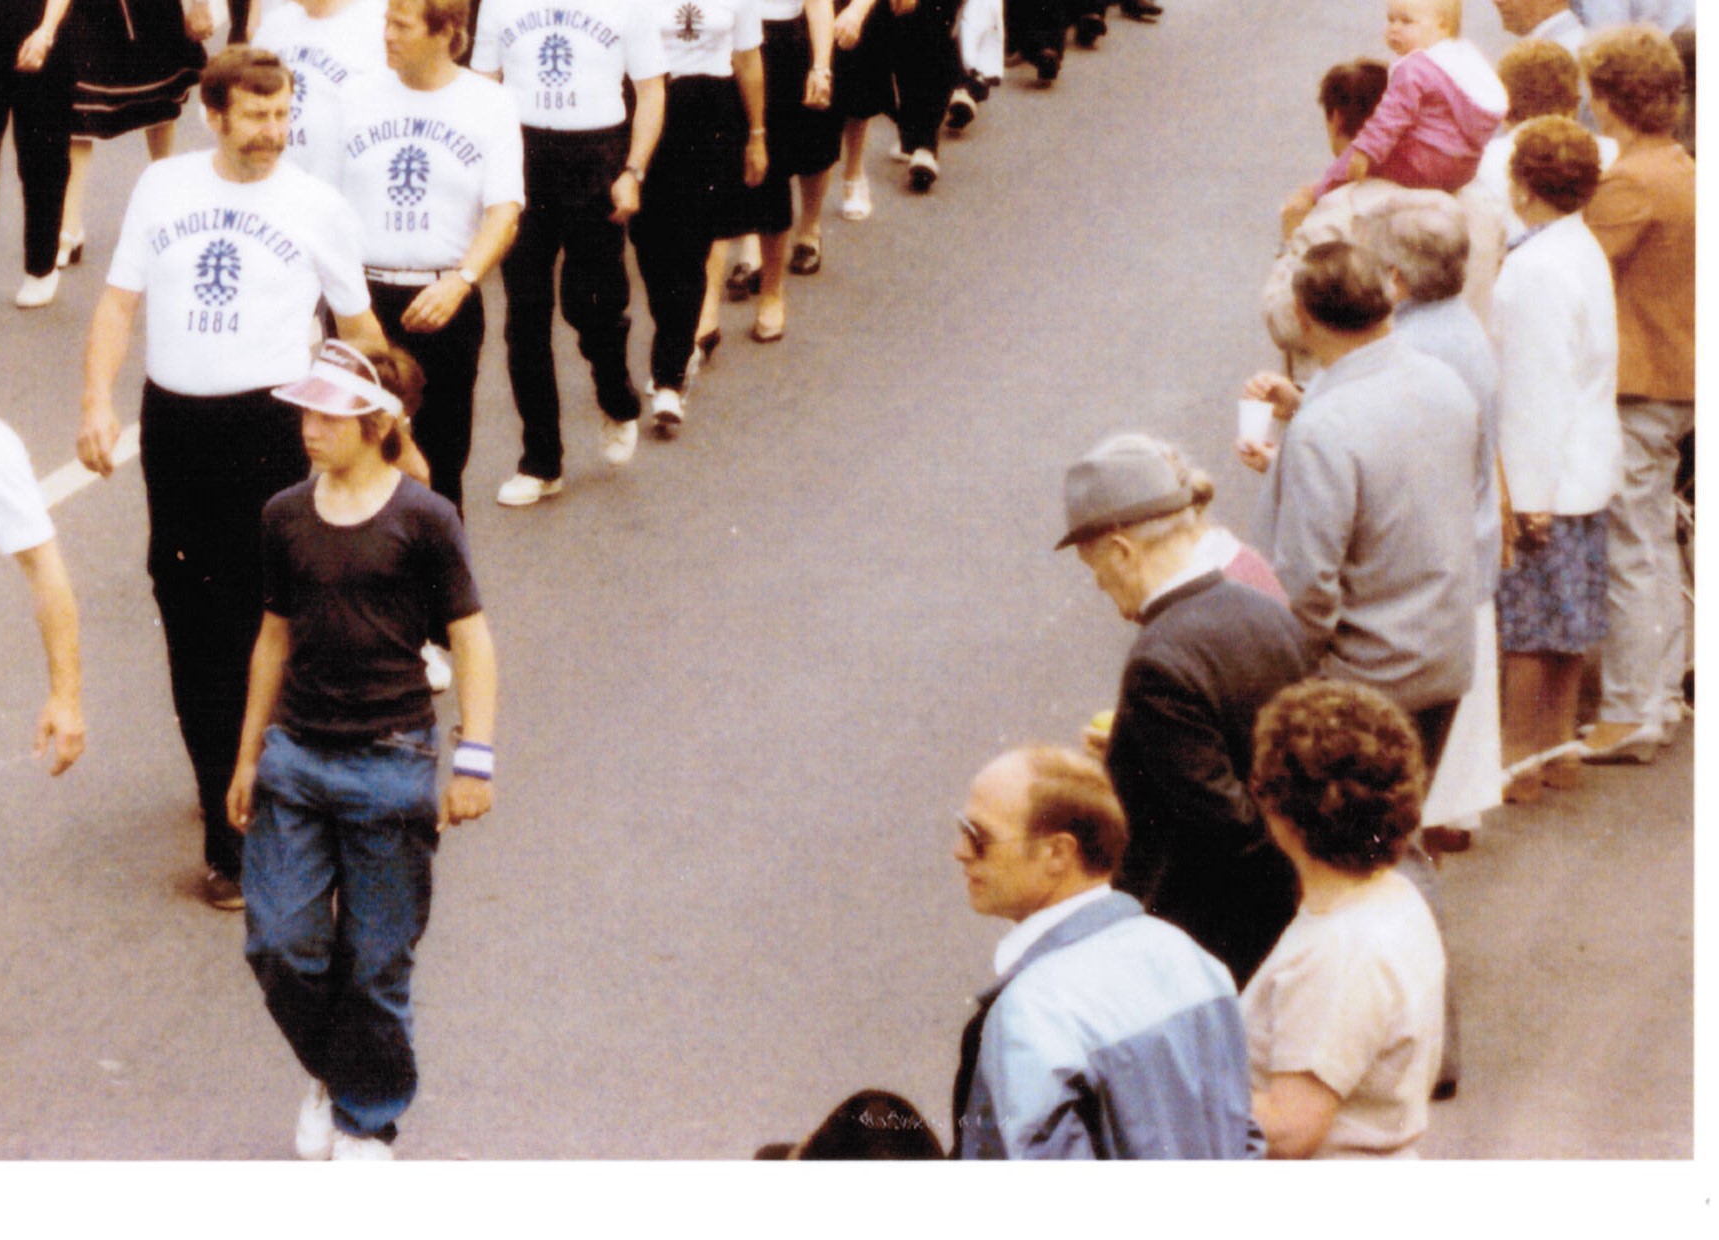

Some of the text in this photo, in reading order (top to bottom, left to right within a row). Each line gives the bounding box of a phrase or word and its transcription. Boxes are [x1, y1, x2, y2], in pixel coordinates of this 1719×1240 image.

[516, 8, 621, 49] HOLZWICKEDE
[535, 90, 576, 110] 1884
[368, 117, 483, 167] HOLZWICKEDE
[173, 208, 302, 265] HOLZWICKEDE
[385, 210, 430, 232] 1884
[187, 310, 240, 334] 1884
